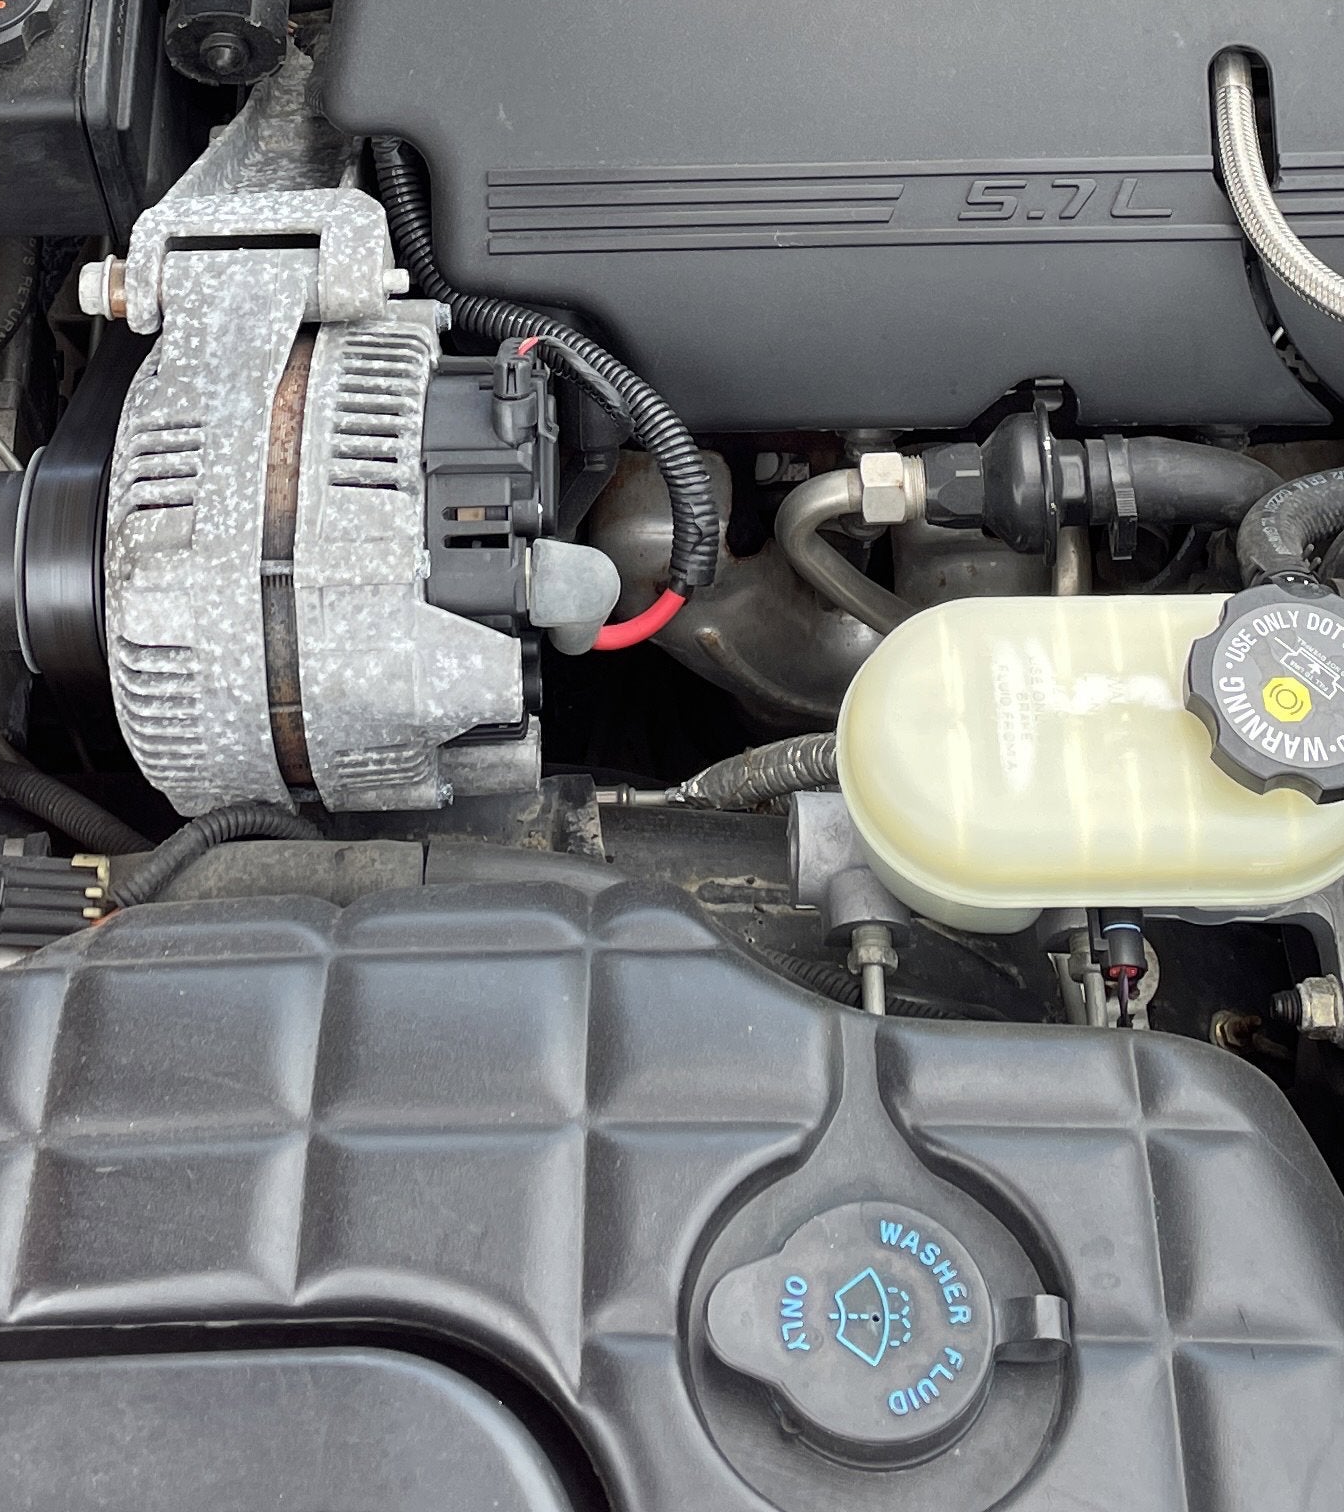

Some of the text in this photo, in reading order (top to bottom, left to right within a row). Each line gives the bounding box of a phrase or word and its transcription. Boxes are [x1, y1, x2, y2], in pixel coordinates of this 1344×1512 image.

[1252, 609, 1300, 638] ONLY
[1225, 628, 1257, 663] USE
[1296, 636, 1328, 662] OVERFILL
[1326, 660, 1341, 672] NOT
[1314, 678, 1329, 692] FILL
[1218, 675, 1329, 763] WARNING
[779, 1275, 811, 1352] ONLY
[878, 1219, 973, 1416] WASHER FLUID
